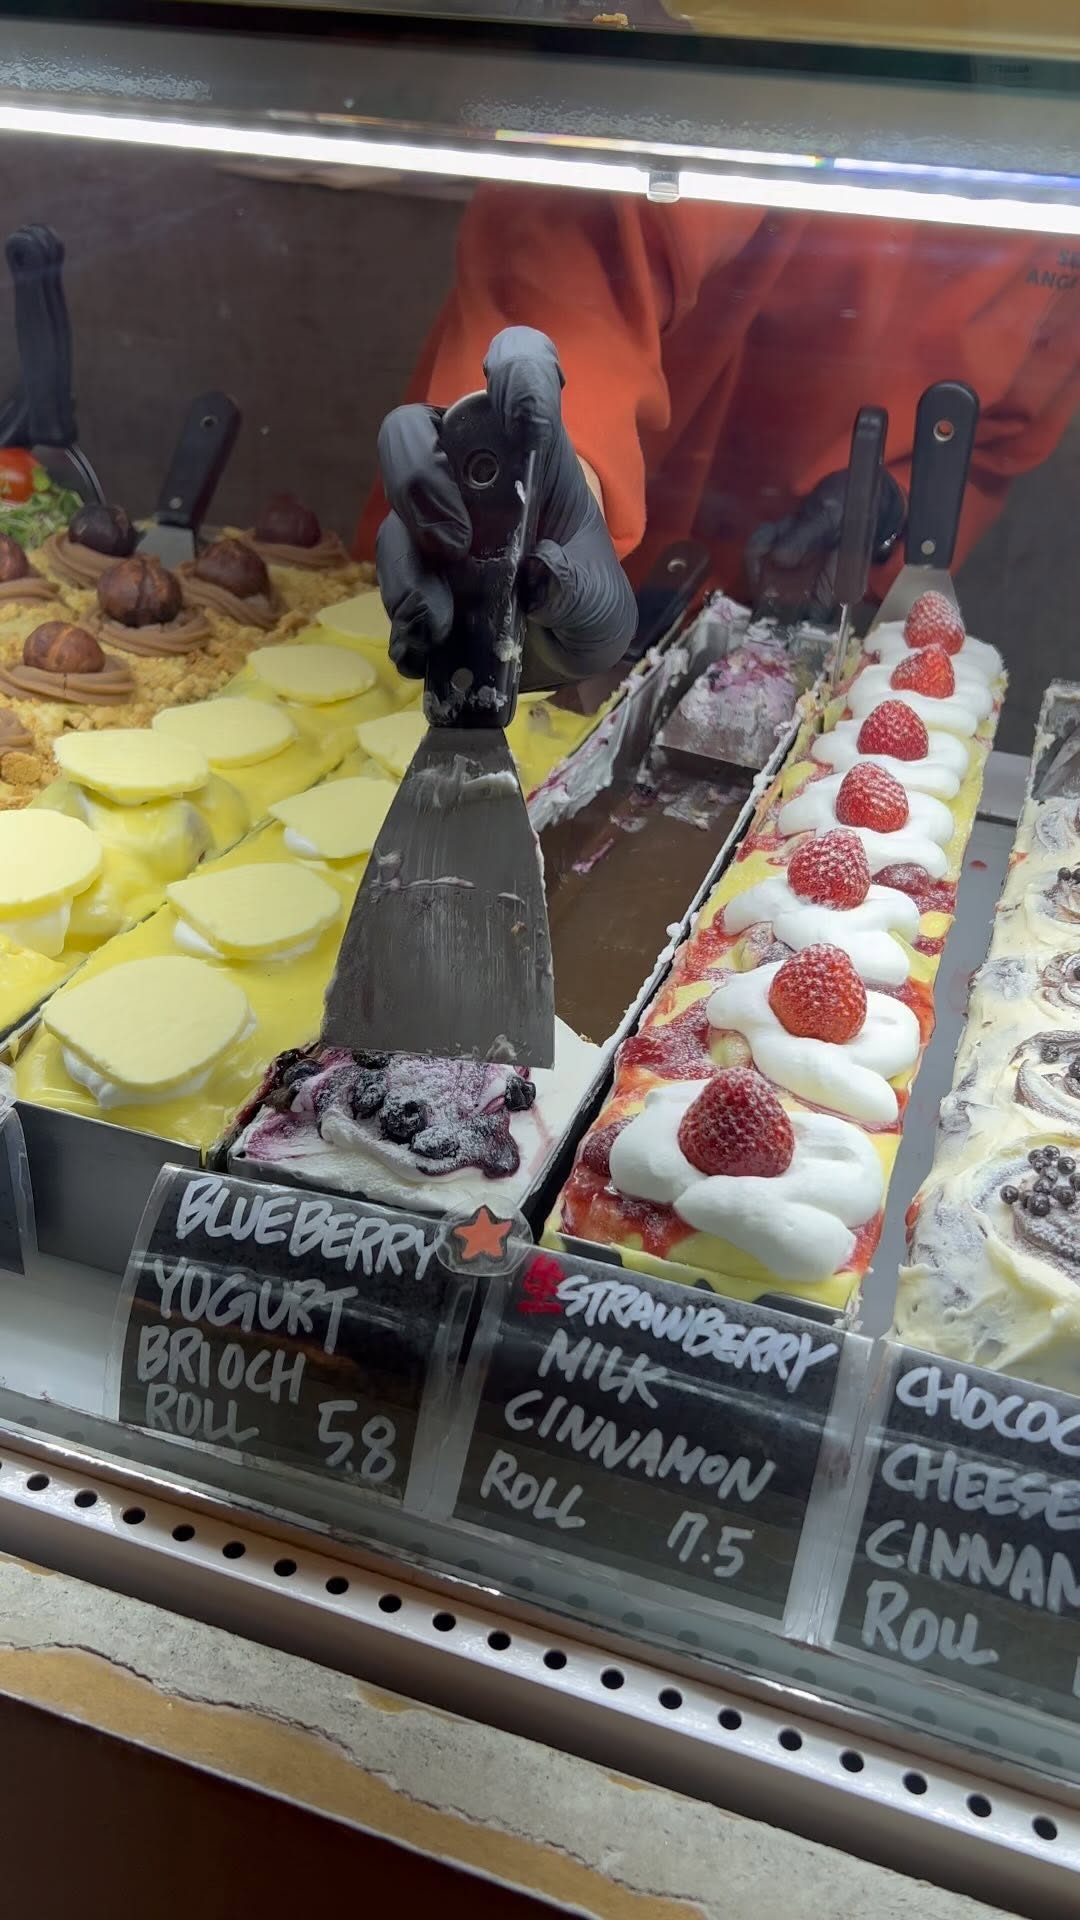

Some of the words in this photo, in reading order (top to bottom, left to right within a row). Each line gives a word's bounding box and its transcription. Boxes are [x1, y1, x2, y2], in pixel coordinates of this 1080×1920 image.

[177, 1178, 443, 1280] BLUEBERRY
[153, 1257, 358, 1354] YOGURT
[556, 1274, 839, 1393] STRAWBERRY
[137, 1324, 306, 1403] BRIOCH
[537, 1328, 668, 1409] MILK
[145, 1384, 259, 1442] ROLL
[317, 1400, 397, 1482] 5.8
[504, 1389, 777, 1501] CINNAMON
[480, 1450, 586, 1528] ROLL
[881, 1443, 1080, 1530] CHEESE
[861, 1579, 999, 1665] ROLL
